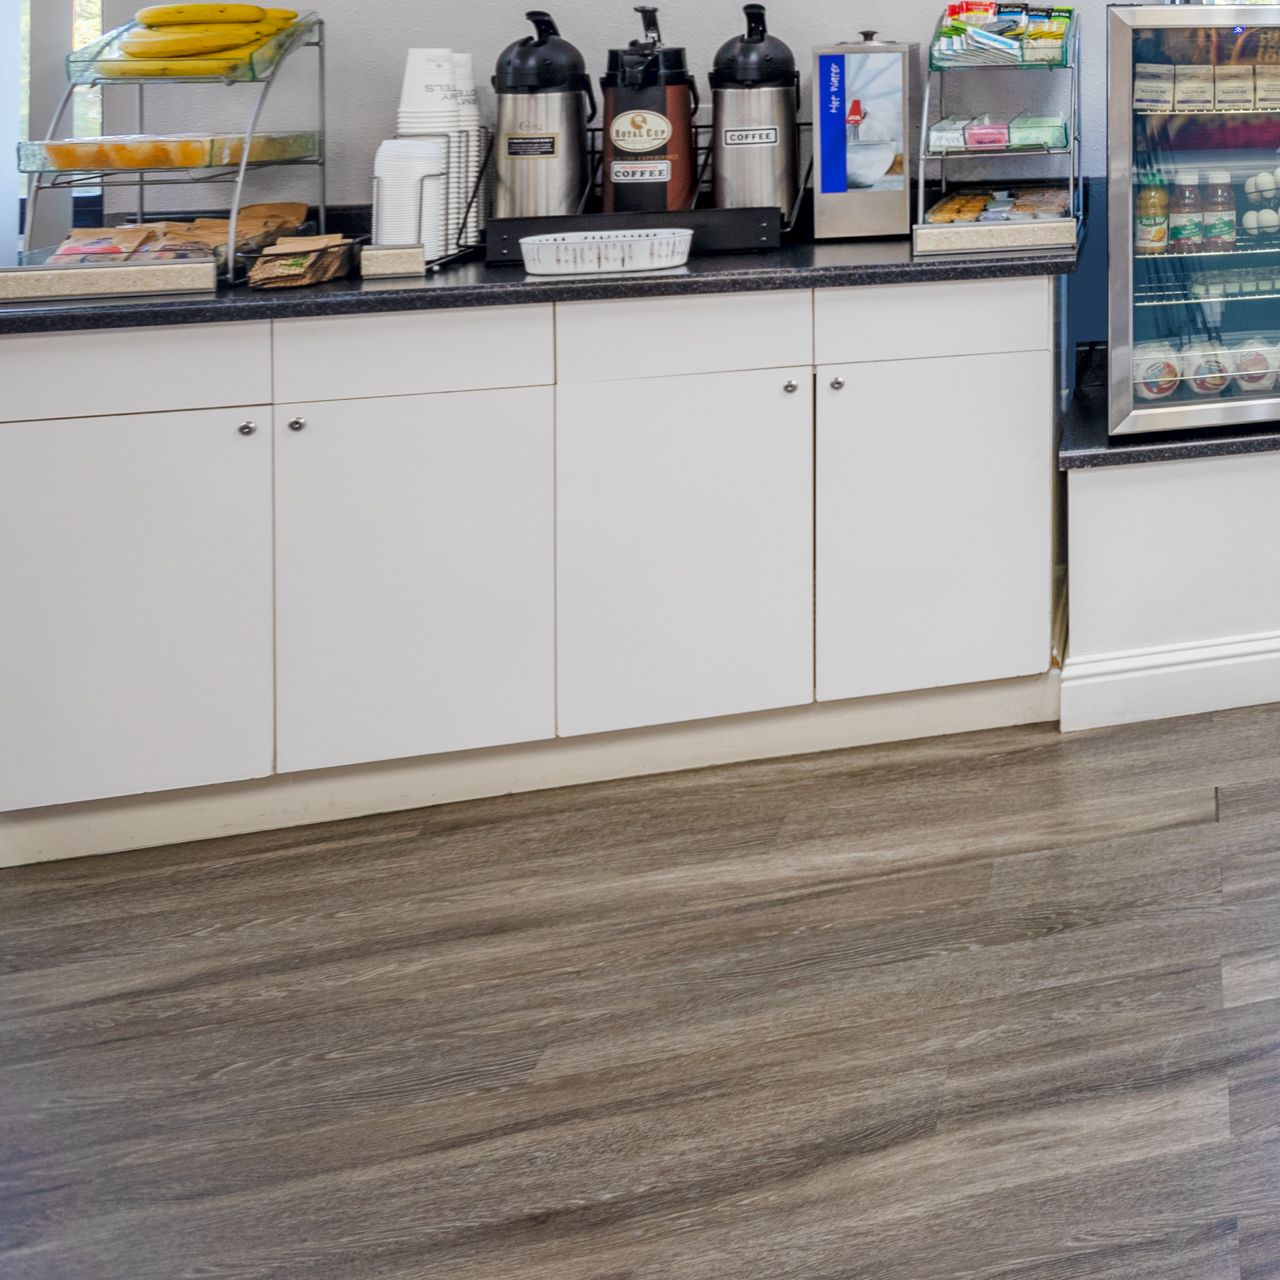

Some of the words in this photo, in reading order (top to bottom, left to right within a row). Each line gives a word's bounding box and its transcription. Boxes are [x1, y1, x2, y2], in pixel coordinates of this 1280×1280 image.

[829, 63, 840, 92] Water
[828, 95, 840, 113] Hot
[730, 132, 772, 142] COFFEE
[614, 169, 666, 178] COFFEE
